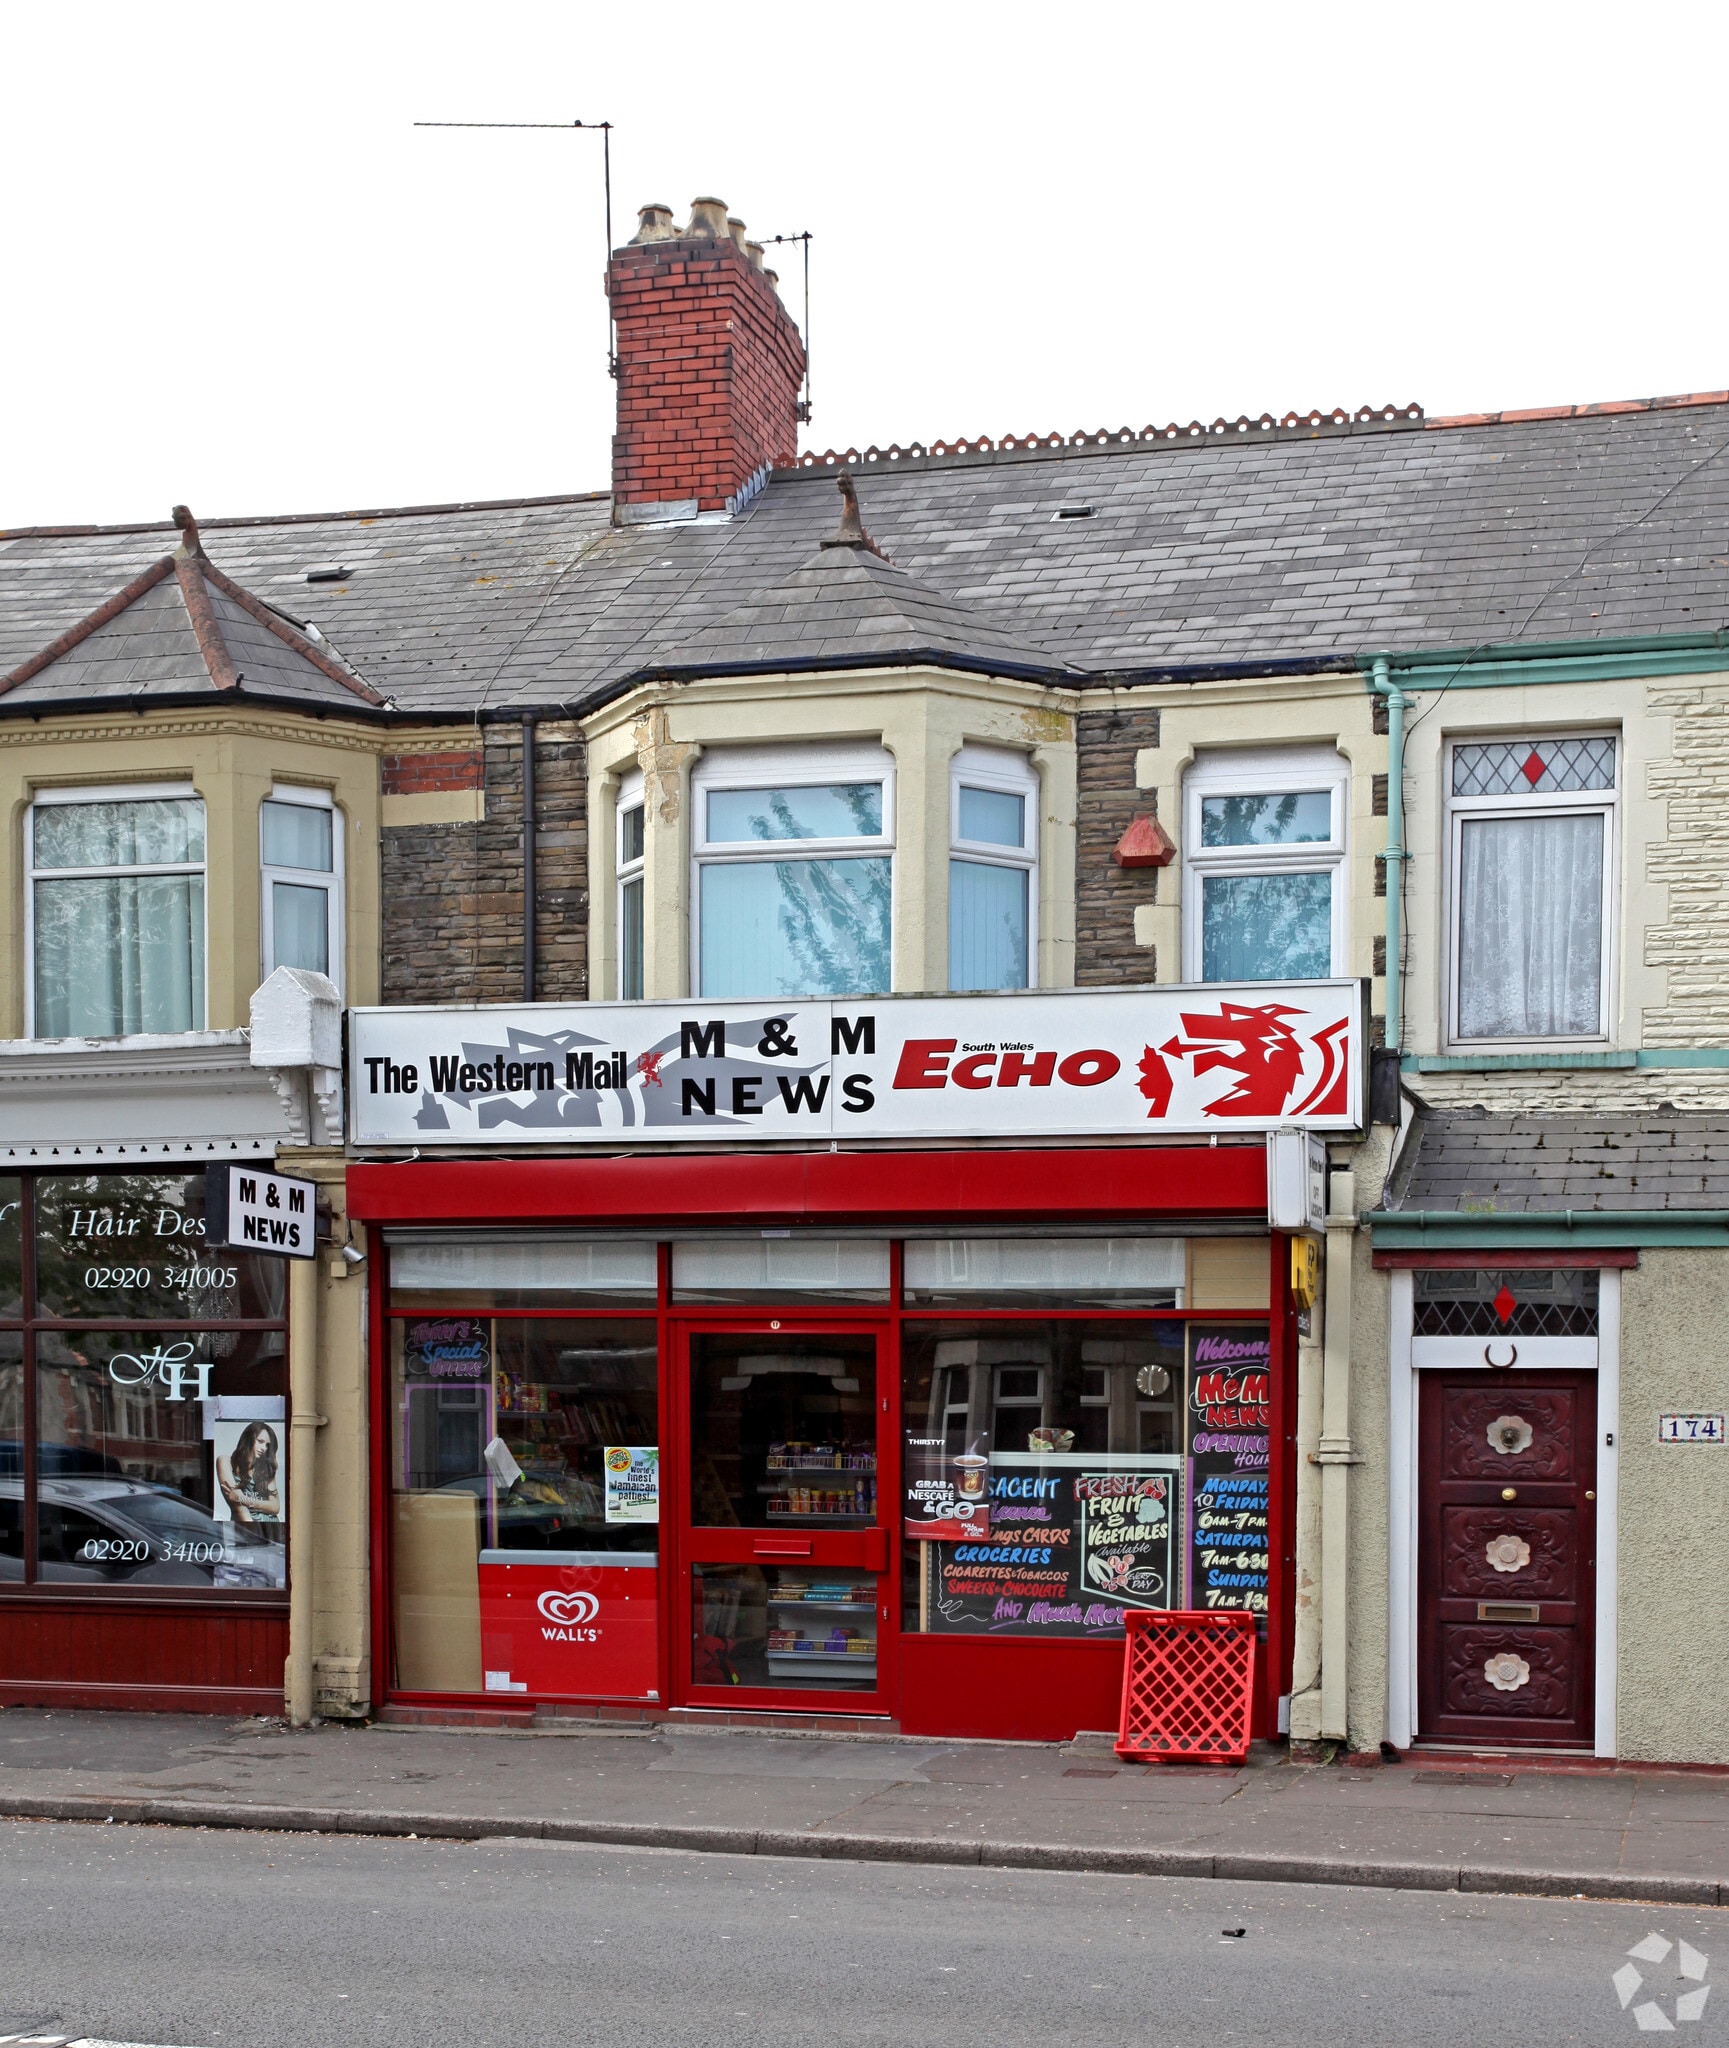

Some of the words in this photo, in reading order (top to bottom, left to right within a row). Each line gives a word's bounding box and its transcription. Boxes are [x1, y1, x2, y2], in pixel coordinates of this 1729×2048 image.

[681, 1021, 725, 1058] M
[757, 1018, 799, 1057] &
[833, 1016, 876, 1055] M
[962, 1043, 996, 1052] South
[999, 1042, 1034, 1051] Wales
[364, 1057, 418, 1094] The
[429, 1054, 555, 1093] Western
[566, 1051, 627, 1090] Mail
[893, 1038, 1121, 1090] ECHO
[682, 1073, 876, 1117] NEWS
[239, 1177, 257, 1204] M
[265, 1182, 281, 1209] &
[289, 1187, 305, 1213] M
[69, 1209, 141, 1237] Hair
[243, 1215, 301, 1248] NEWS
[84, 1267, 151, 1289] 02920
[161, 1267, 238, 1289] 341005
[165, 1363, 215, 1401] H
[1205, 1405, 1270, 1427] NEWS
[1669, 1420, 1717, 1437] 174
[611, 1480, 656, 1493] Jamaican
[915, 1480, 947, 1489] GRAB
[1073, 1475, 1139, 1501] FRESH
[989, 1500, 1052, 1521] icence
[1088, 1493, 1145, 1517] FRUIT
[1194, 1492, 1214, 1507] TO
[1107, 1513, 1125, 1528] &
[1023, 1526, 1071, 1545] CARDS
[1087, 1522, 1168, 1546] VEGETABLES
[84, 1539, 149, 1561] 02920
[160, 1541, 235, 1563] 341005
[954, 1545, 1052, 1565] GROCERIES
[1131, 1578, 1154, 1590] DAY
[1027, 1601, 1085, 1625] Much
[1083, 1603, 1125, 1627] Mor
[541, 1627, 598, 1642] WALL'S
